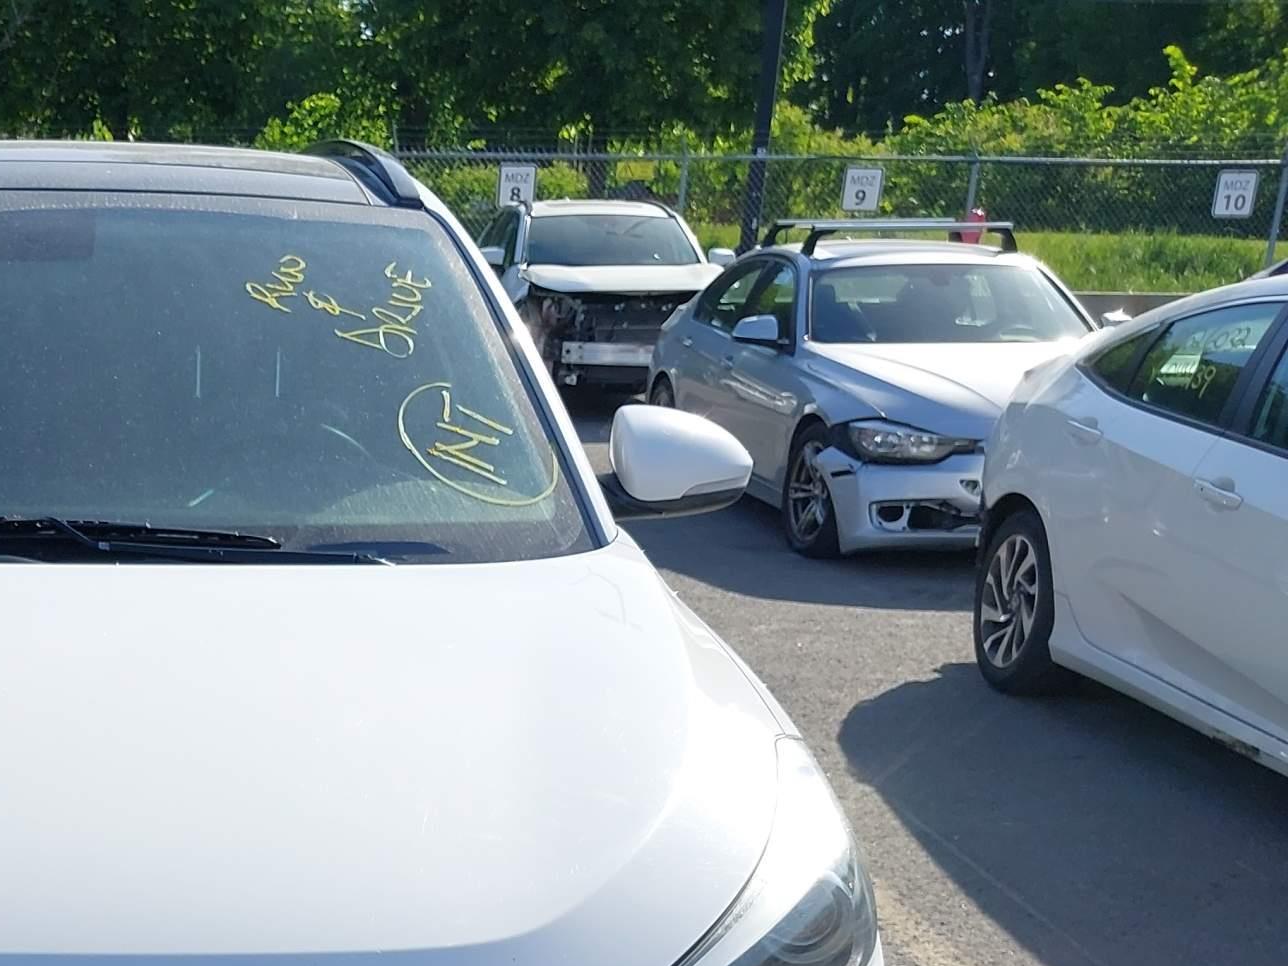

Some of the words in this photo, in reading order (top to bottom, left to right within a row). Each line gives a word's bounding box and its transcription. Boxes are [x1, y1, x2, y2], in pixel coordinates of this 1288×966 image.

[505, 173, 530, 184] MDZ
[850, 175, 876, 188] MDZ
[1223, 180, 1250, 192] MDZ
[510, 187, 521, 202] 8
[855, 189, 866, 206] 9
[1223, 194, 1246, 211] 10
